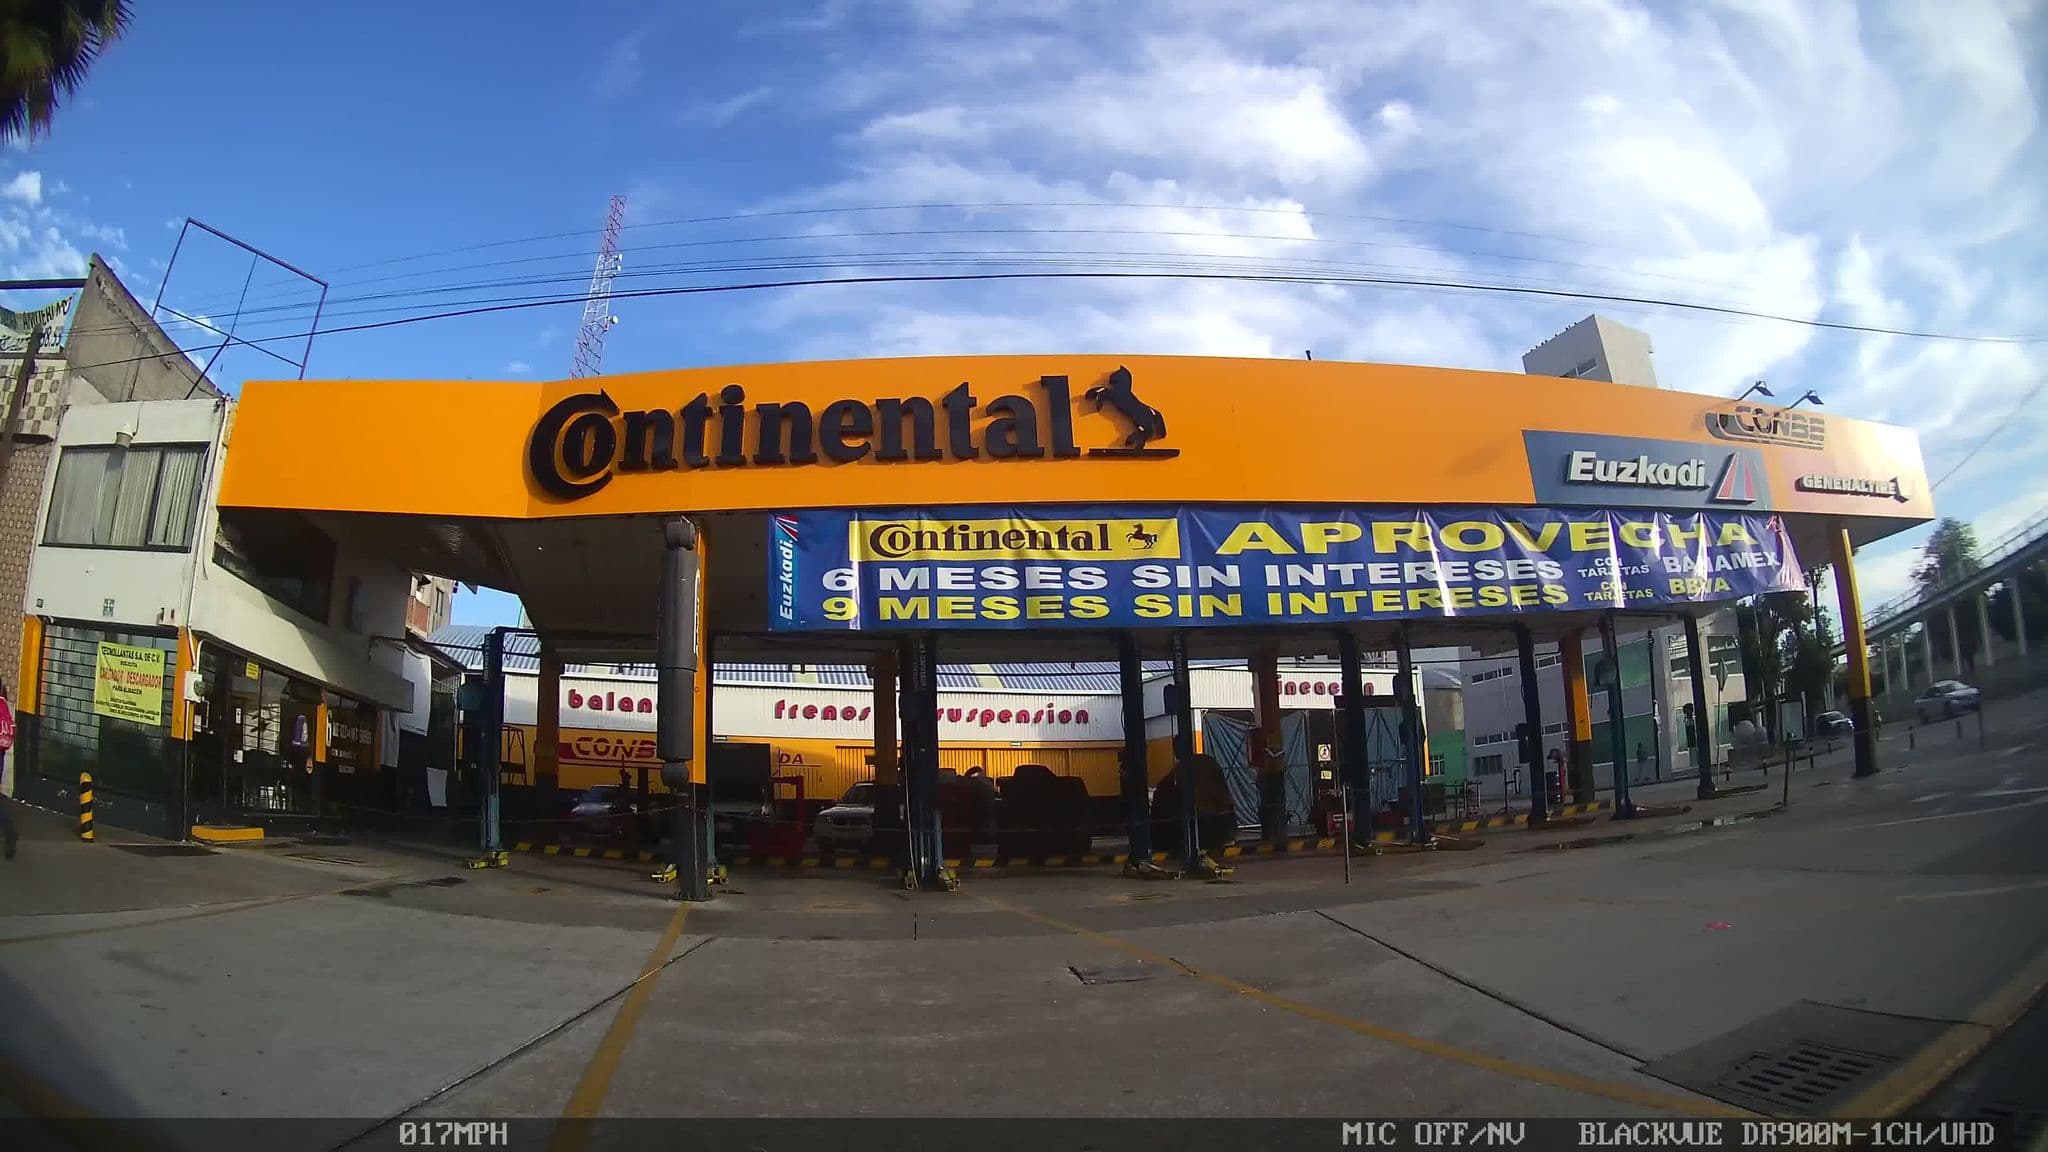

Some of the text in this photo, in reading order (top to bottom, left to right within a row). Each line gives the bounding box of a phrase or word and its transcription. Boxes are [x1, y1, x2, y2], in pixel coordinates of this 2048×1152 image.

[530, 375, 1080, 502] Continental
[1568, 450, 1706, 487] Euzkadi
[869, 523, 1113, 558] Continental
[1215, 521, 1759, 555] APROVECHA
[780, 540, 793, 620] Euzkadi
[822, 559, 1564, 591] 6 MESES SIN INTERESES
[822, 584, 1570, 621] 9 MESES SIN INTERESES
[774, 699, 871, 721] frenos
